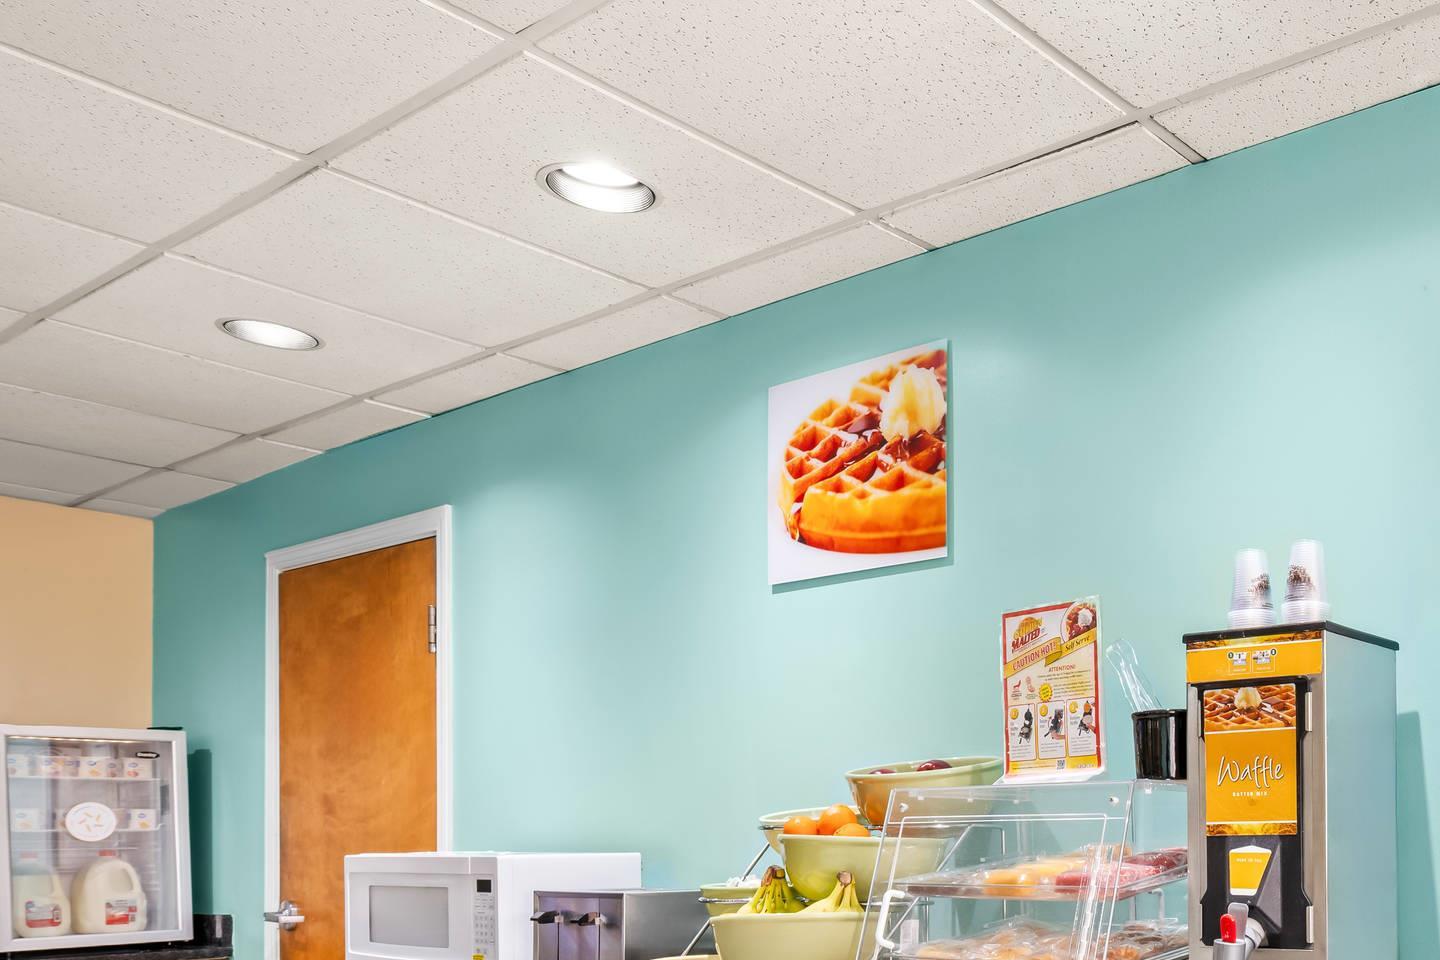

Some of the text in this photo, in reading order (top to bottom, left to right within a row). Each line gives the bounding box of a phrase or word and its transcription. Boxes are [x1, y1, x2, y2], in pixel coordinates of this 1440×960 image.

[1075, 635, 1090, 645] Serve
[1012, 641, 1056, 671] CAUTION HOT!
[1048, 664, 1076, 672] ATTENTION!
[1216, 756, 1284, 788] Waffle
